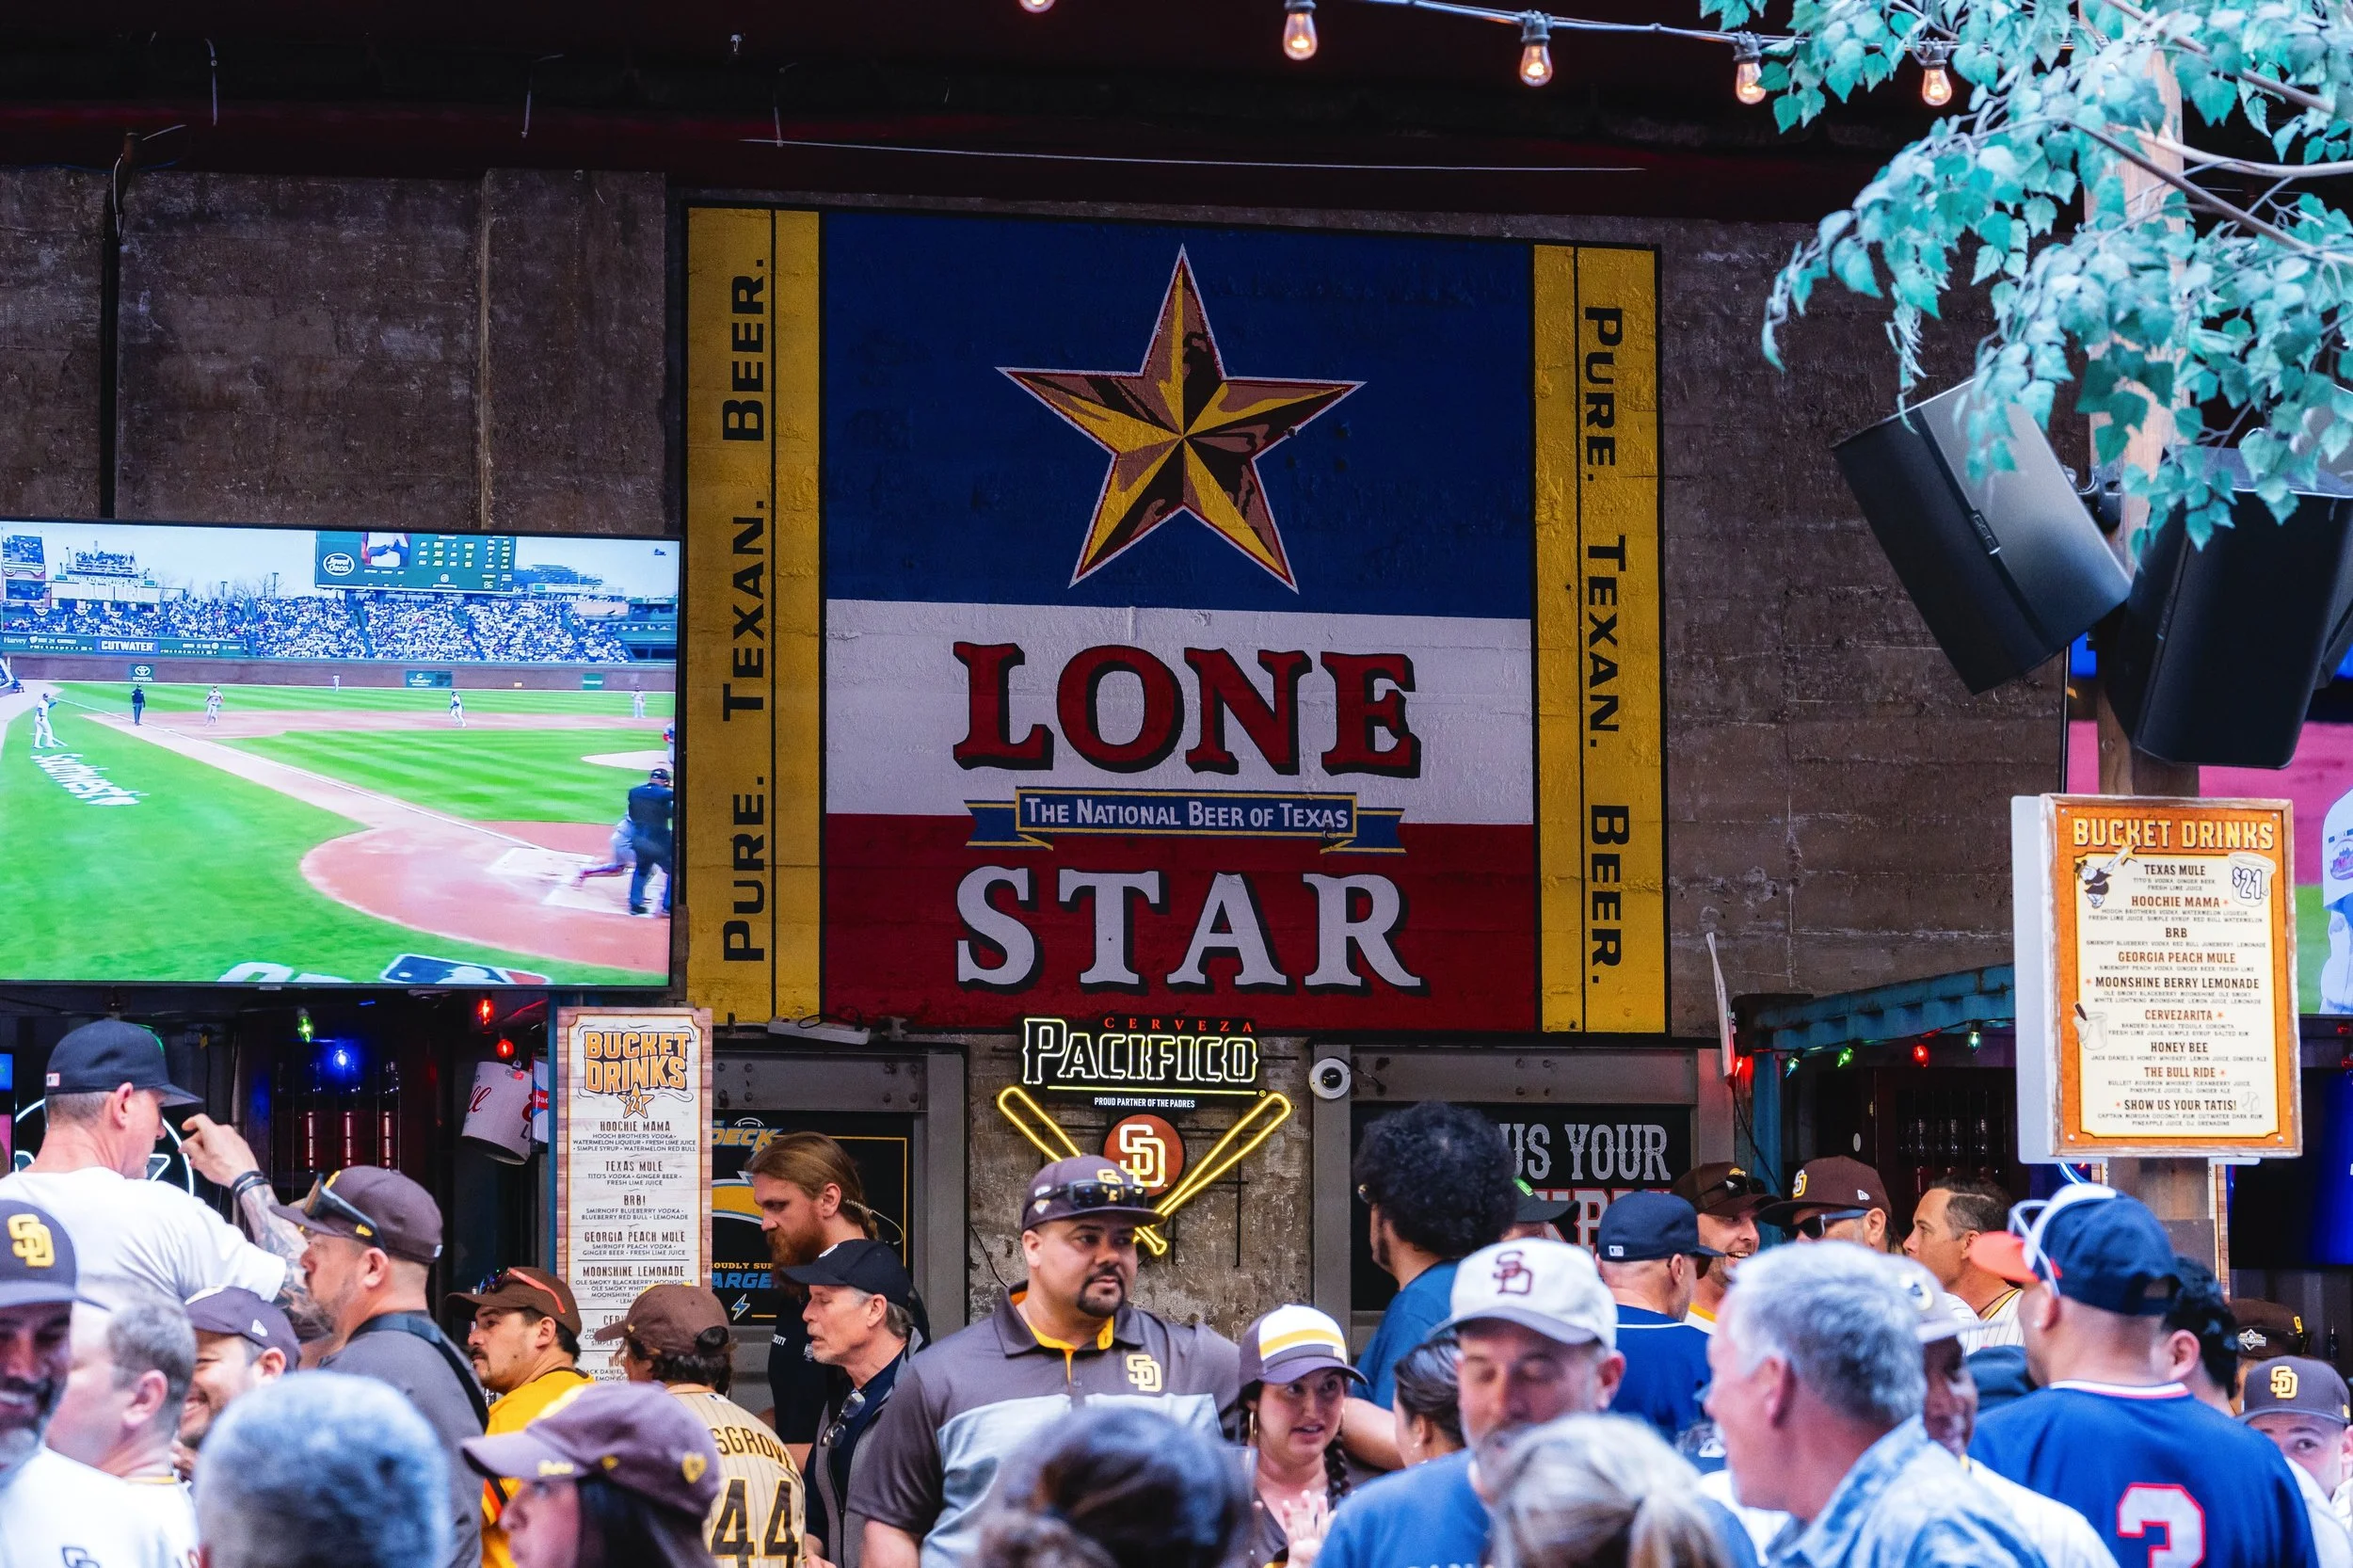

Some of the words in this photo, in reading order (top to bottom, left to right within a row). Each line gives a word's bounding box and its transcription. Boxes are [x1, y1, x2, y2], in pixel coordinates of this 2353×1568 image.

[722, 259, 764, 441] BEER.
[1585, 307, 1623, 482] PURE.
[722, 500, 764, 721] TEXAN.
[1588, 535, 1626, 748] TEXAN.
[952, 641, 1421, 778] LONE
[1025, 797, 1069, 824] THE
[1077, 799, 1181, 825] NATIONAL
[1188, 801, 1245, 827] BEER
[1250, 808, 1274, 828] OF
[1279, 803, 1349, 829] TEXAS
[2073, 818, 2172, 847] BUCKET
[2181, 820, 2274, 850] DRINKS
[722, 776, 764, 961] PURE.
[2144, 866, 2176, 875] TEXAS
[2179, 867, 2205, 875] MULE
[1591, 805, 1630, 984] BEER.
[2232, 867, 2262, 900] $21
[2132, 896, 2181, 907] HOOCHIE
[2185, 897, 2219, 907] MAMA
[956, 864, 1431, 996] STAR
[2165, 927, 2187, 938] BRB
[2118, 952, 2165, 963] GEORGIA
[2169, 952, 2203, 963] PEACH
[2207, 952, 2235, 964] MULE
[2095, 977, 2160, 988] MOONSHINE
[2164, 977, 2199, 988] BERRY
[2202, 978, 2259, 988] LEMONADE
[1103, 1016, 1254, 1032] CERVEZA
[2145, 1010, 2213, 1020] CERVEZARITA
[584, 1032, 690, 1060] BUCKET
[1022, 1017, 1259, 1085] PACIFICO
[2151, 1042, 2185, 1052] HONEY
[2189, 1042, 2208, 1053] BEE
[585, 1055, 687, 1095] DRINKS
[2144, 1066, 2163, 1078] THE
[2167, 1066, 2190, 1078] BULL
[2193, 1067, 2216, 1078] RIDE
[625, 1095, 644, 1112] $21
[1094, 1097, 1116, 1107] PROUD
[1116, 1097, 1146, 1107] PARTNER
[1147, 1098, 1157, 1107] OF
[1157, 1098, 1169, 1108] THE
[1170, 1099, 1195, 1109] PADRES
[2124, 1099, 2154, 1111] SHOW
[2157, 1099, 2170, 1111] US
[2173, 1099, 2201, 1111] YOUR
[2204, 1099, 2236, 1111] TATIS!
[600, 1121, 638, 1132] HOOCHIE
[643, 1121, 670, 1131] MAMA
[1119, 1124, 1167, 1188] SD
[1564, 1124, 1672, 1181] YOUR
[605, 1160, 634, 1172] TEXAS
[639, 1160, 663, 1172] MULE
[624, 1194, 646, 1206] BRB!
[584, 1231, 623, 1242] GEORGIA
[628, 1231, 657, 1242] PEACH
[662, 1231, 685, 1242] MULE
[583, 1266, 632, 1277] MOONSHINE
[638, 1266, 684, 1276] LEMONADE
[709, 1478, 799, 1568] 44
